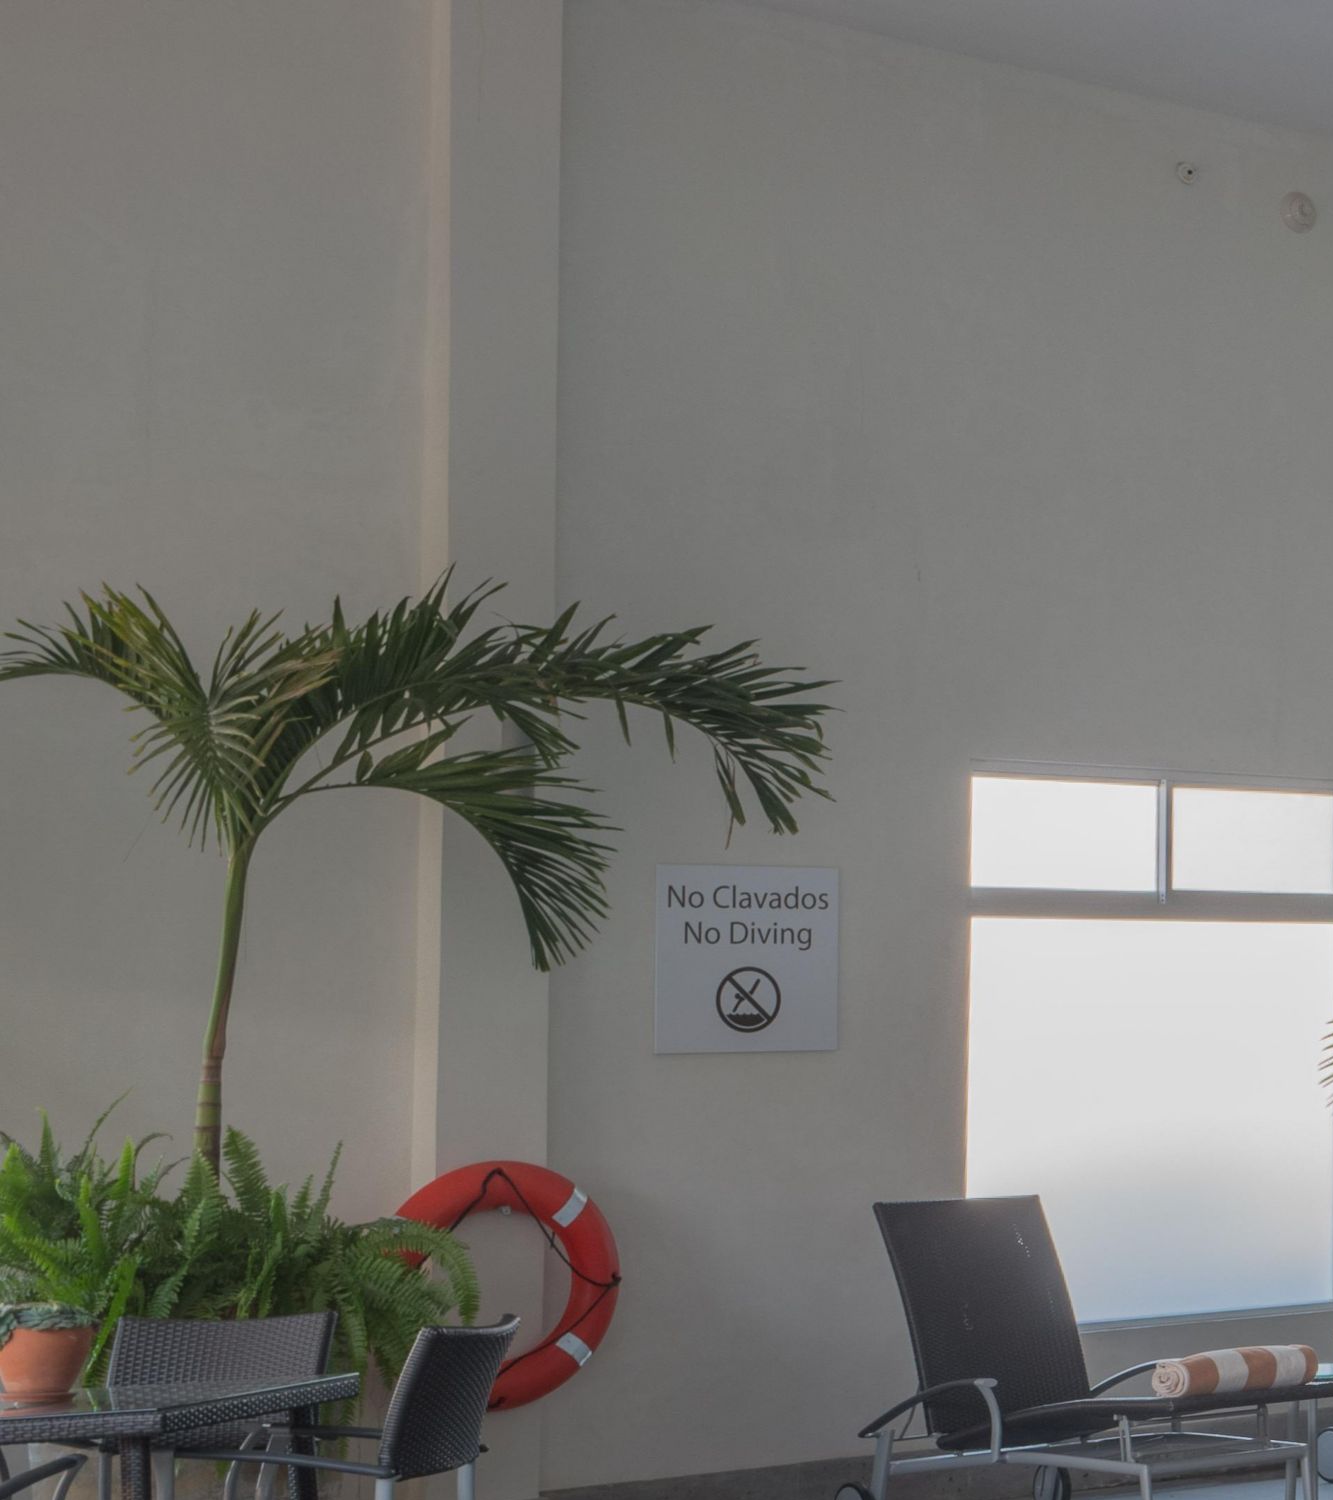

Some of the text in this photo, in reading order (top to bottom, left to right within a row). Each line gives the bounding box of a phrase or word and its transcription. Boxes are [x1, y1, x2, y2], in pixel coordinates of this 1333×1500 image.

[668, 885, 829, 910] No Clavados
[684, 921, 812, 951] No Diving
